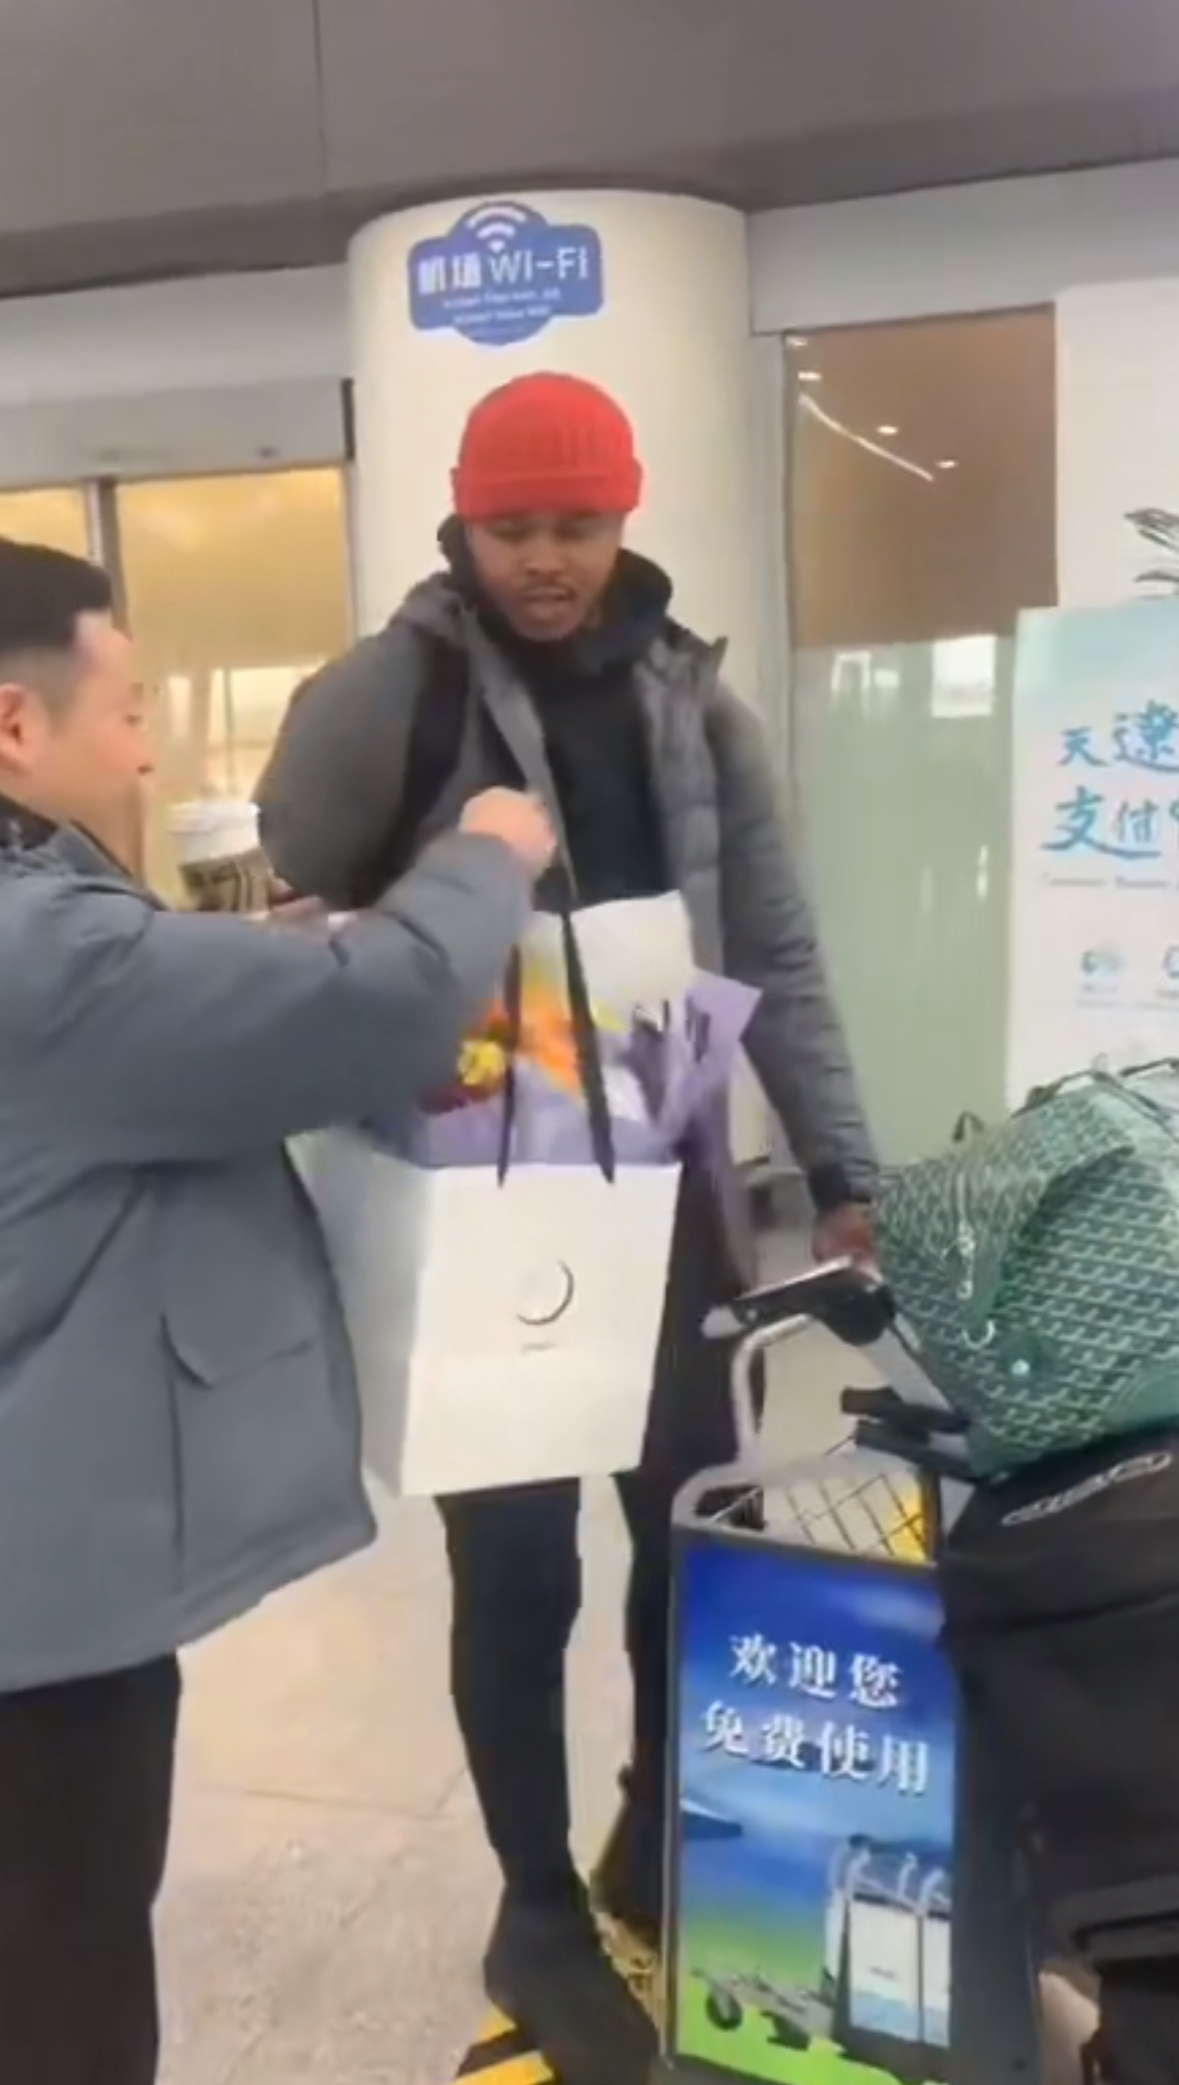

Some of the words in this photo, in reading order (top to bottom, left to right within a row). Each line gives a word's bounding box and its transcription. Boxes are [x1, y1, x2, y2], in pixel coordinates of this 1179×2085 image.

[1039, 785, 1179, 859] 支付
[729, 1632, 902, 1708] 欢迎您
[702, 1699, 929, 1795] 免费使用
